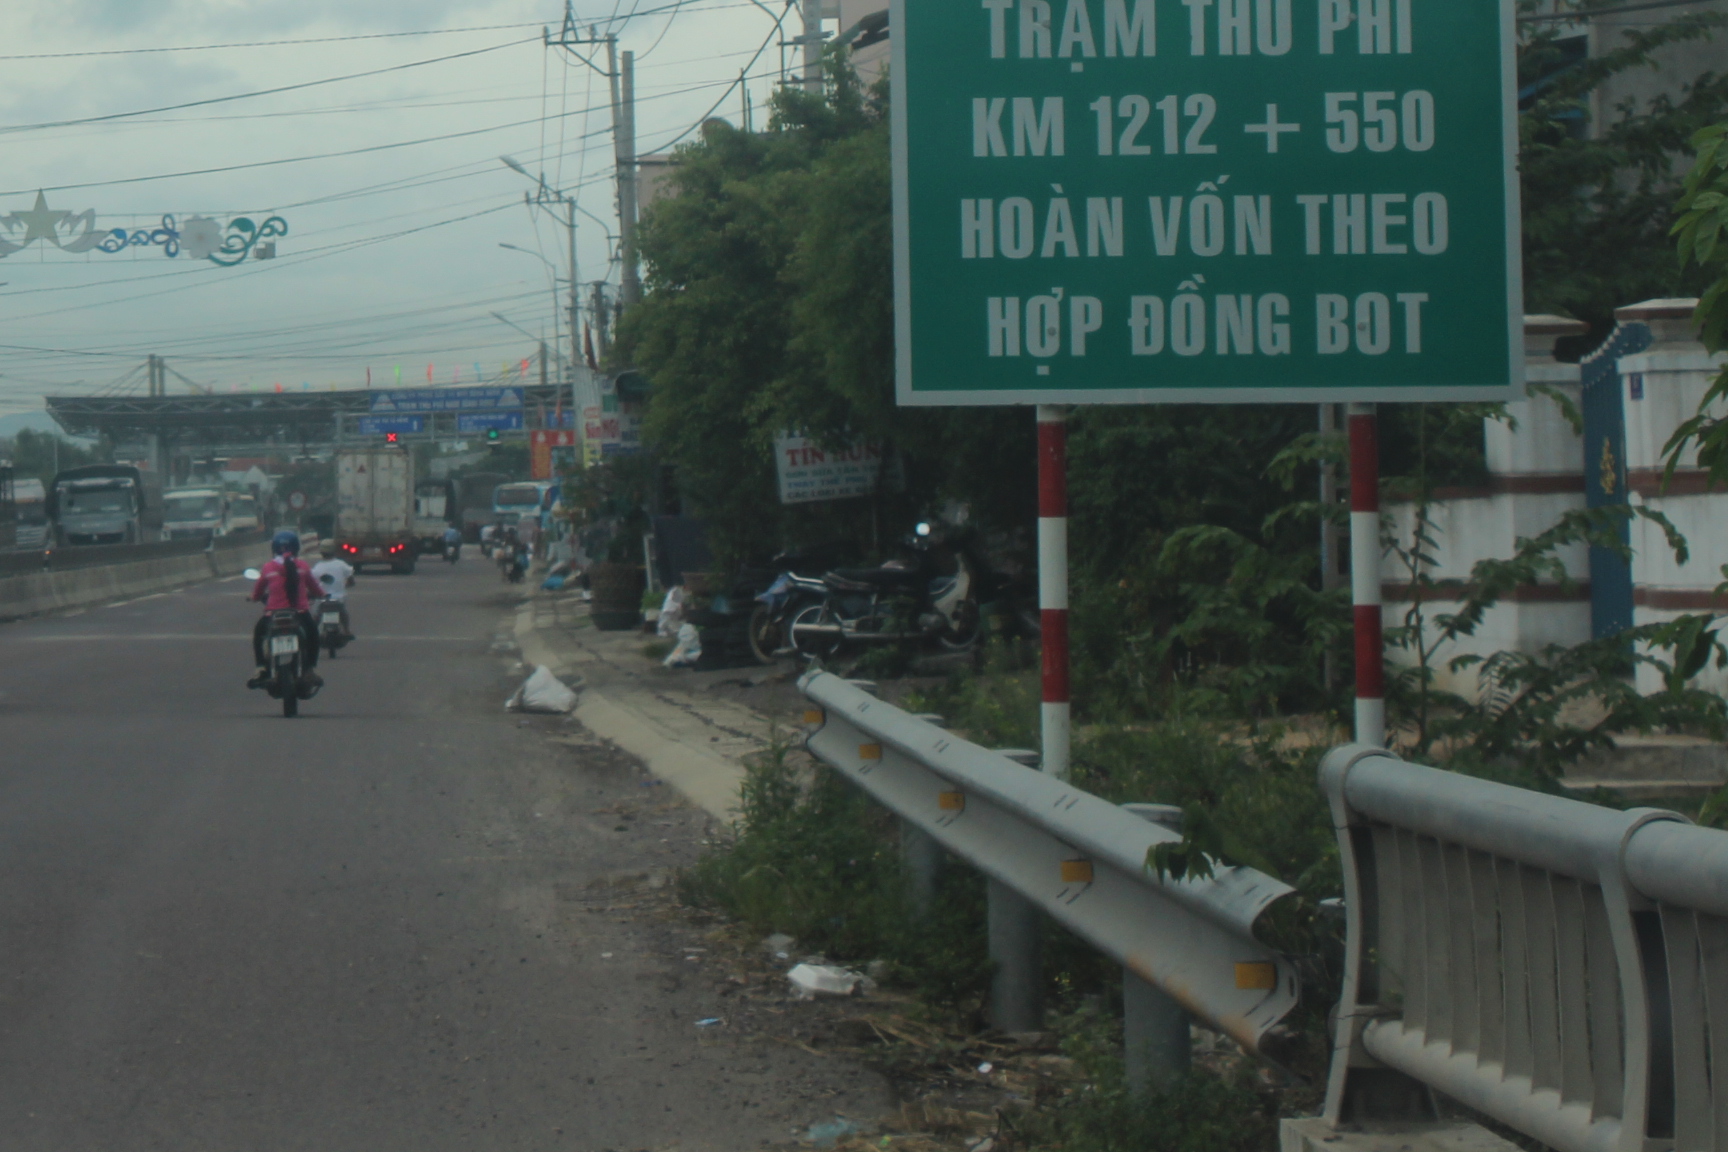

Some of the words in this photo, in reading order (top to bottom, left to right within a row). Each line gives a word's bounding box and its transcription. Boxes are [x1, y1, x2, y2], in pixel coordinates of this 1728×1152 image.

[971, 96, 1065, 157] KM
[1089, 92, 1217, 156] 1212
[1244, 103, 1300, 153] +
[1324, 89, 1435, 153] 550
[960, 183, 1124, 259] HOÀN
[1148, 174, 1272, 256] VỐN
[1296, 191, 1449, 256] THEO
[987, 286, 1103, 376] HỢP
[1127, 274, 1291, 356] ĐỒNG
[1315, 290, 1429, 356] BOT
